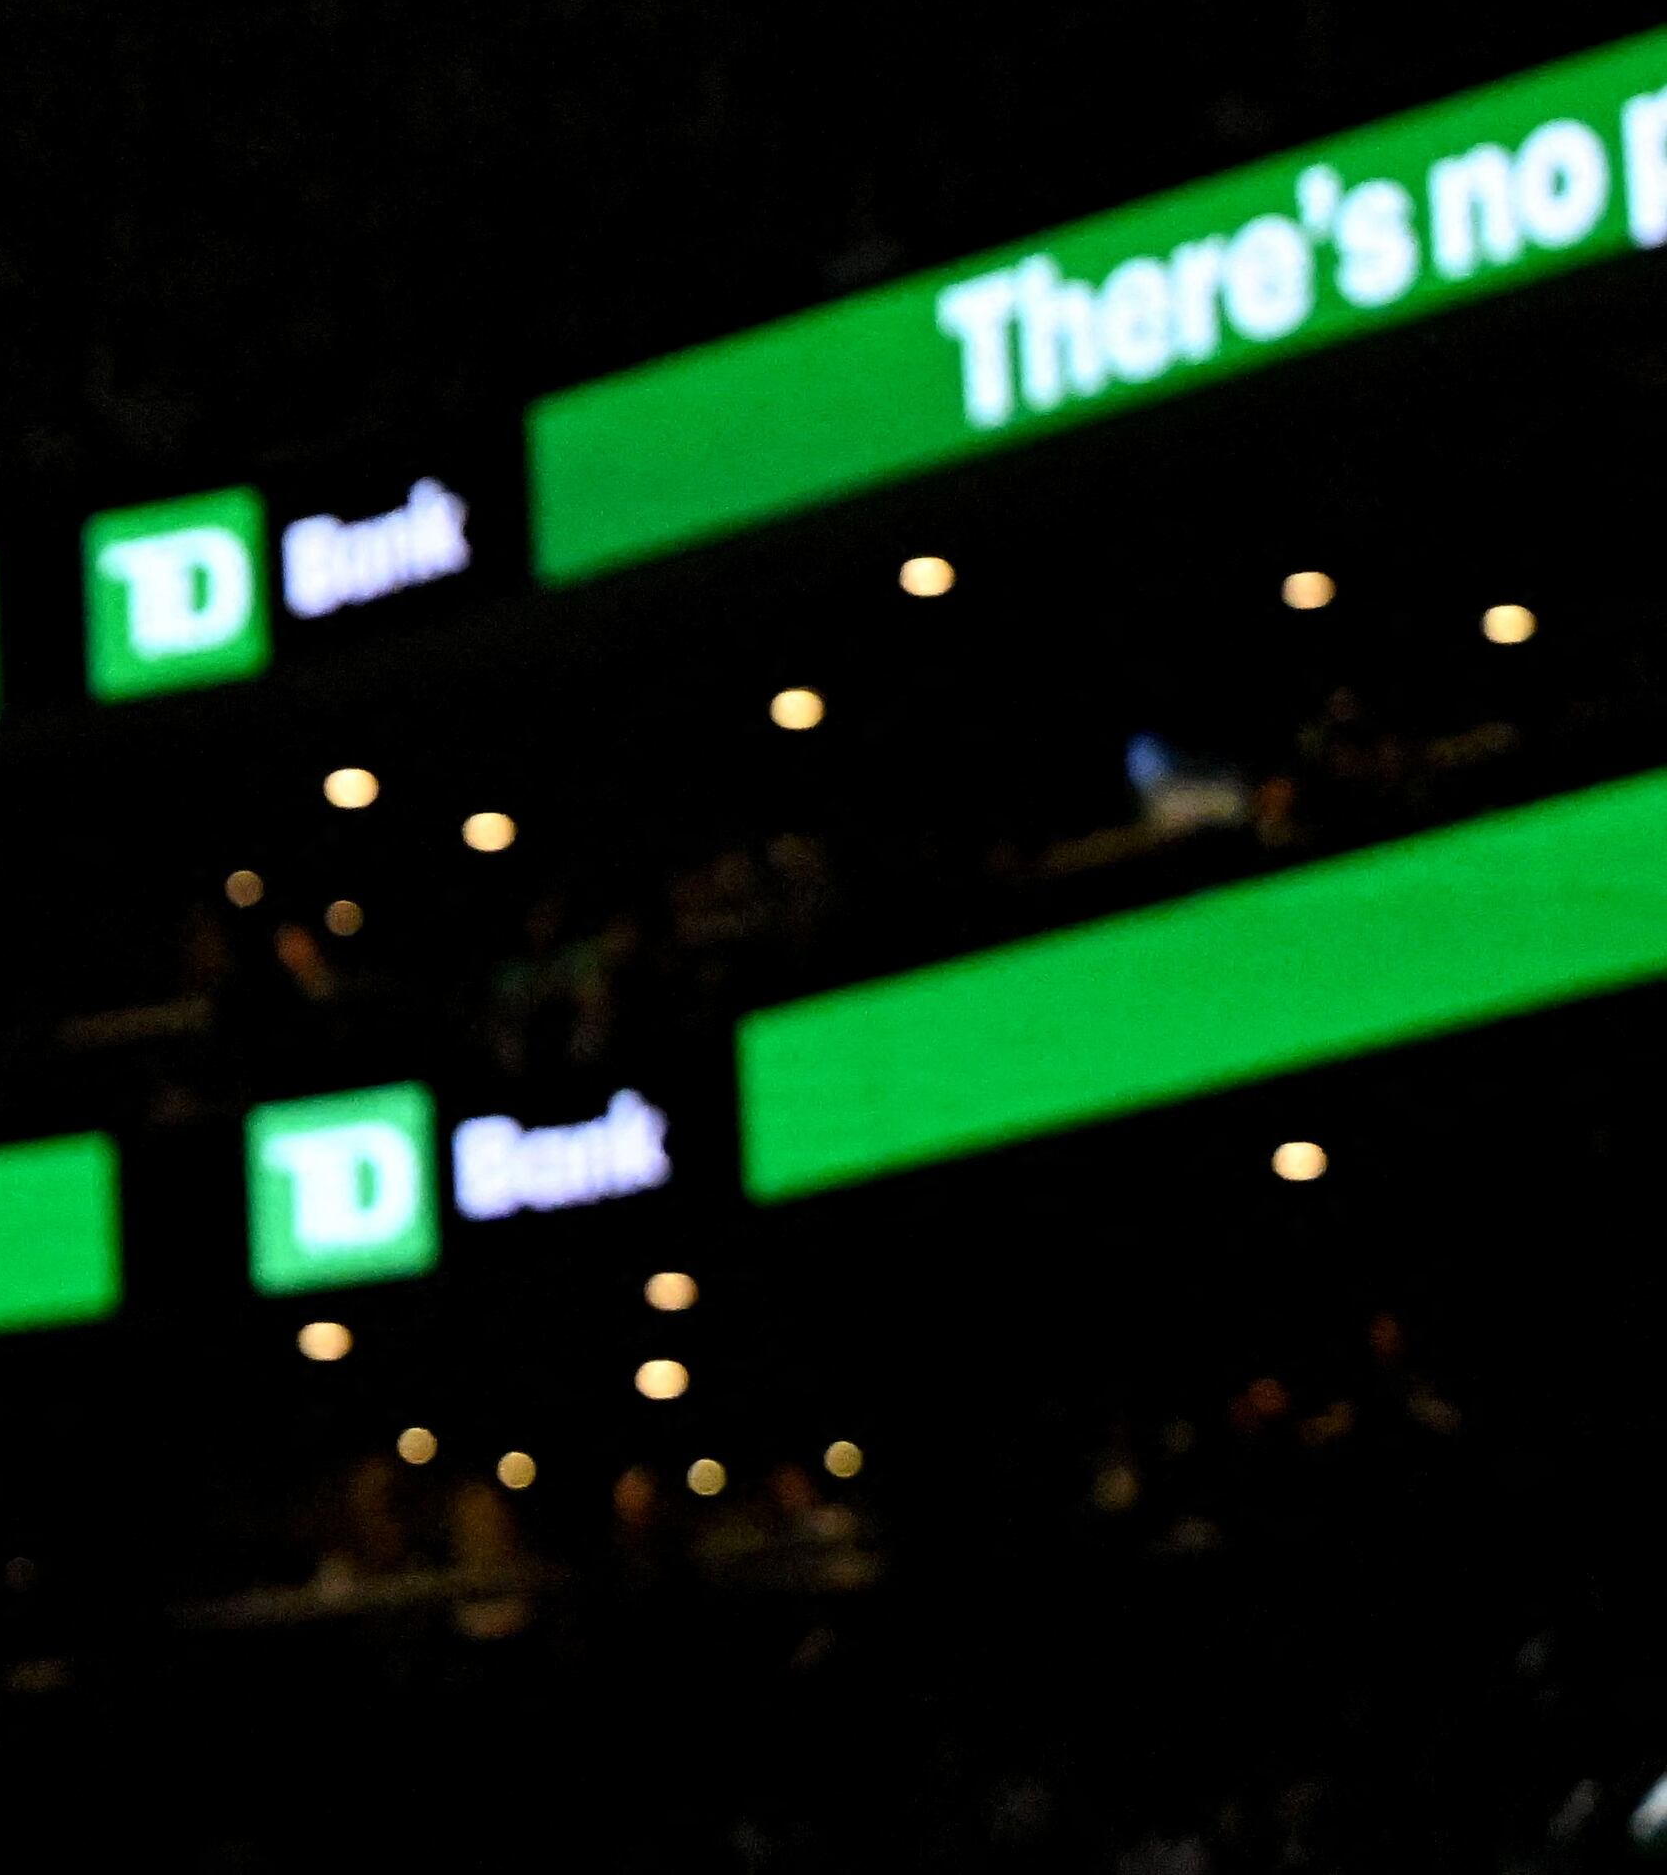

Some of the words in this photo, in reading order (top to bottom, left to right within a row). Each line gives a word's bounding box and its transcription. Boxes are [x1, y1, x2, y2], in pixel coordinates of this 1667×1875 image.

[937, 165, 1419, 427] There's
[1428, 118, 1609, 278] no
[99, 525, 254, 660] TD
[283, 478, 469, 617] Bank
[261, 1116, 423, 1259] TD
[453, 1088, 669, 1219] Bank
